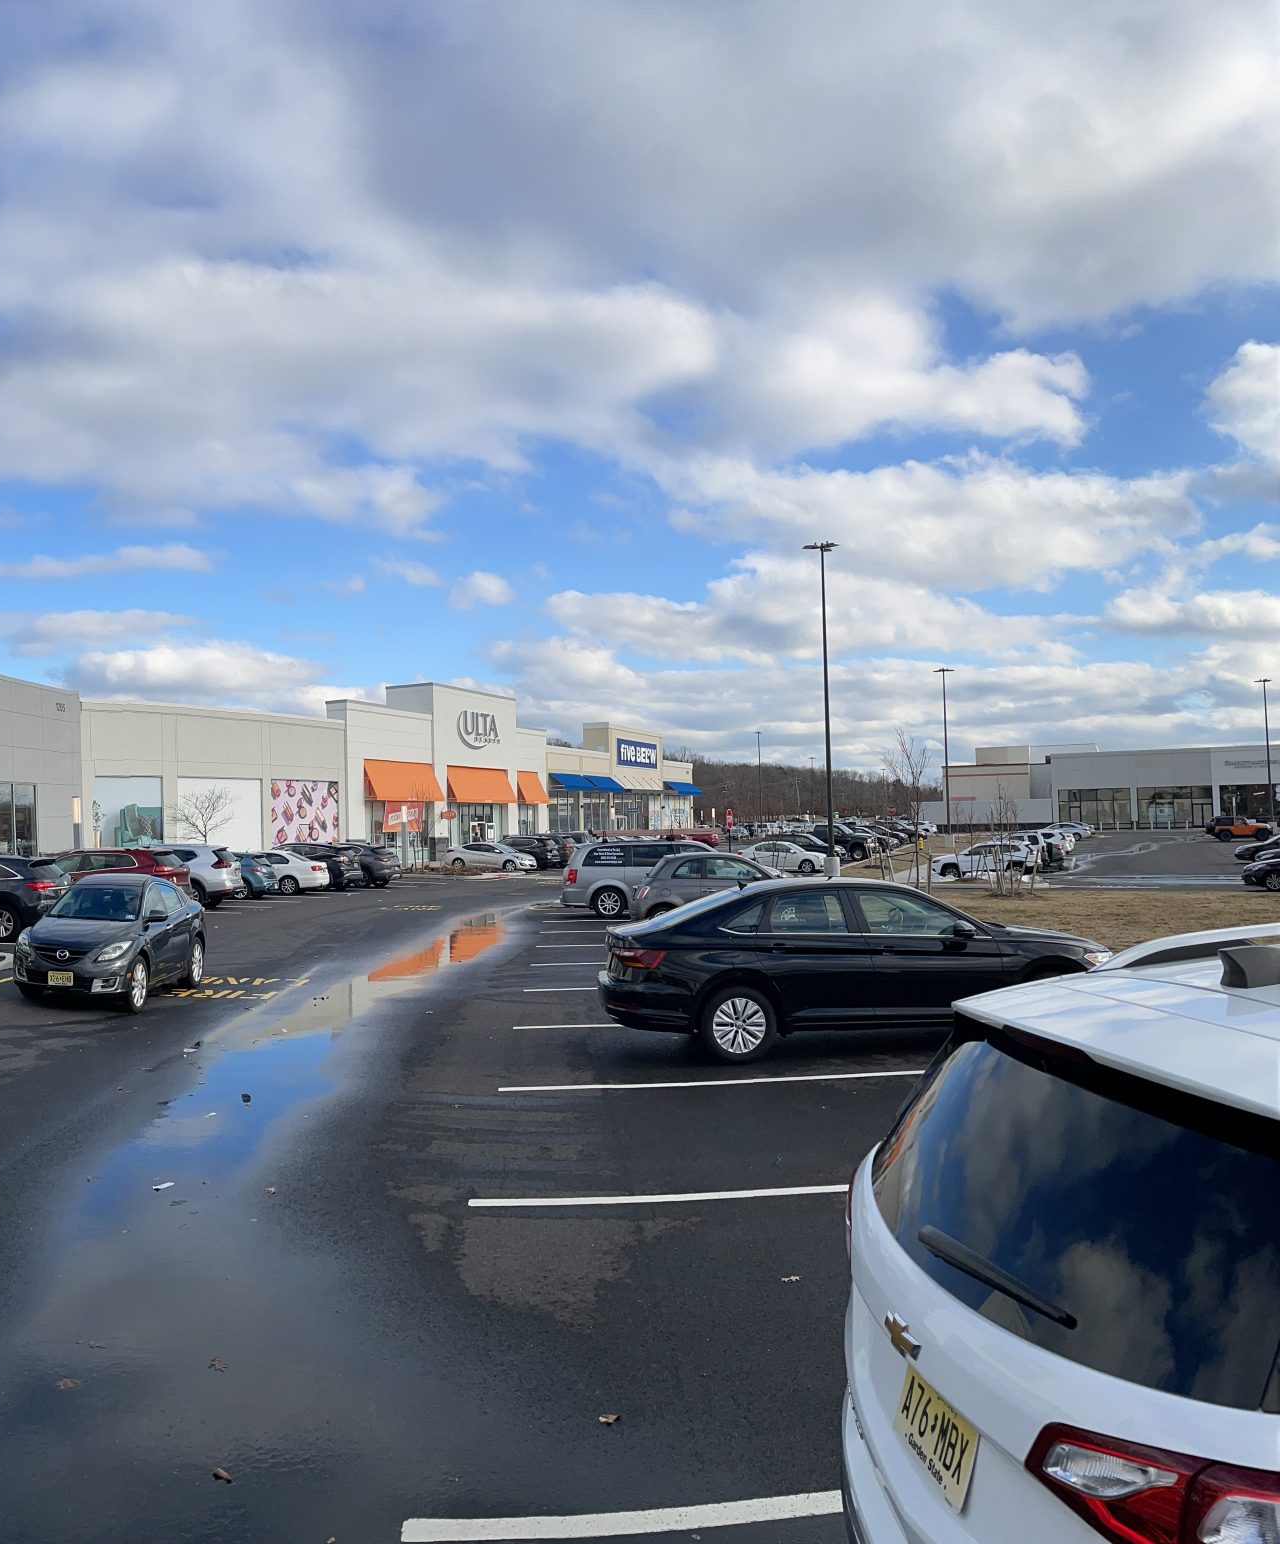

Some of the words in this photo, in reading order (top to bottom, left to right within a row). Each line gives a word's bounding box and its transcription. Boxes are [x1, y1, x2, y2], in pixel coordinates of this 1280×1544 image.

[463, 710, 499, 738] ULTA
[621, 744, 636, 762] five
[907, 1433, 928, 1467] Garden
[927, 1458, 944, 1486] State
